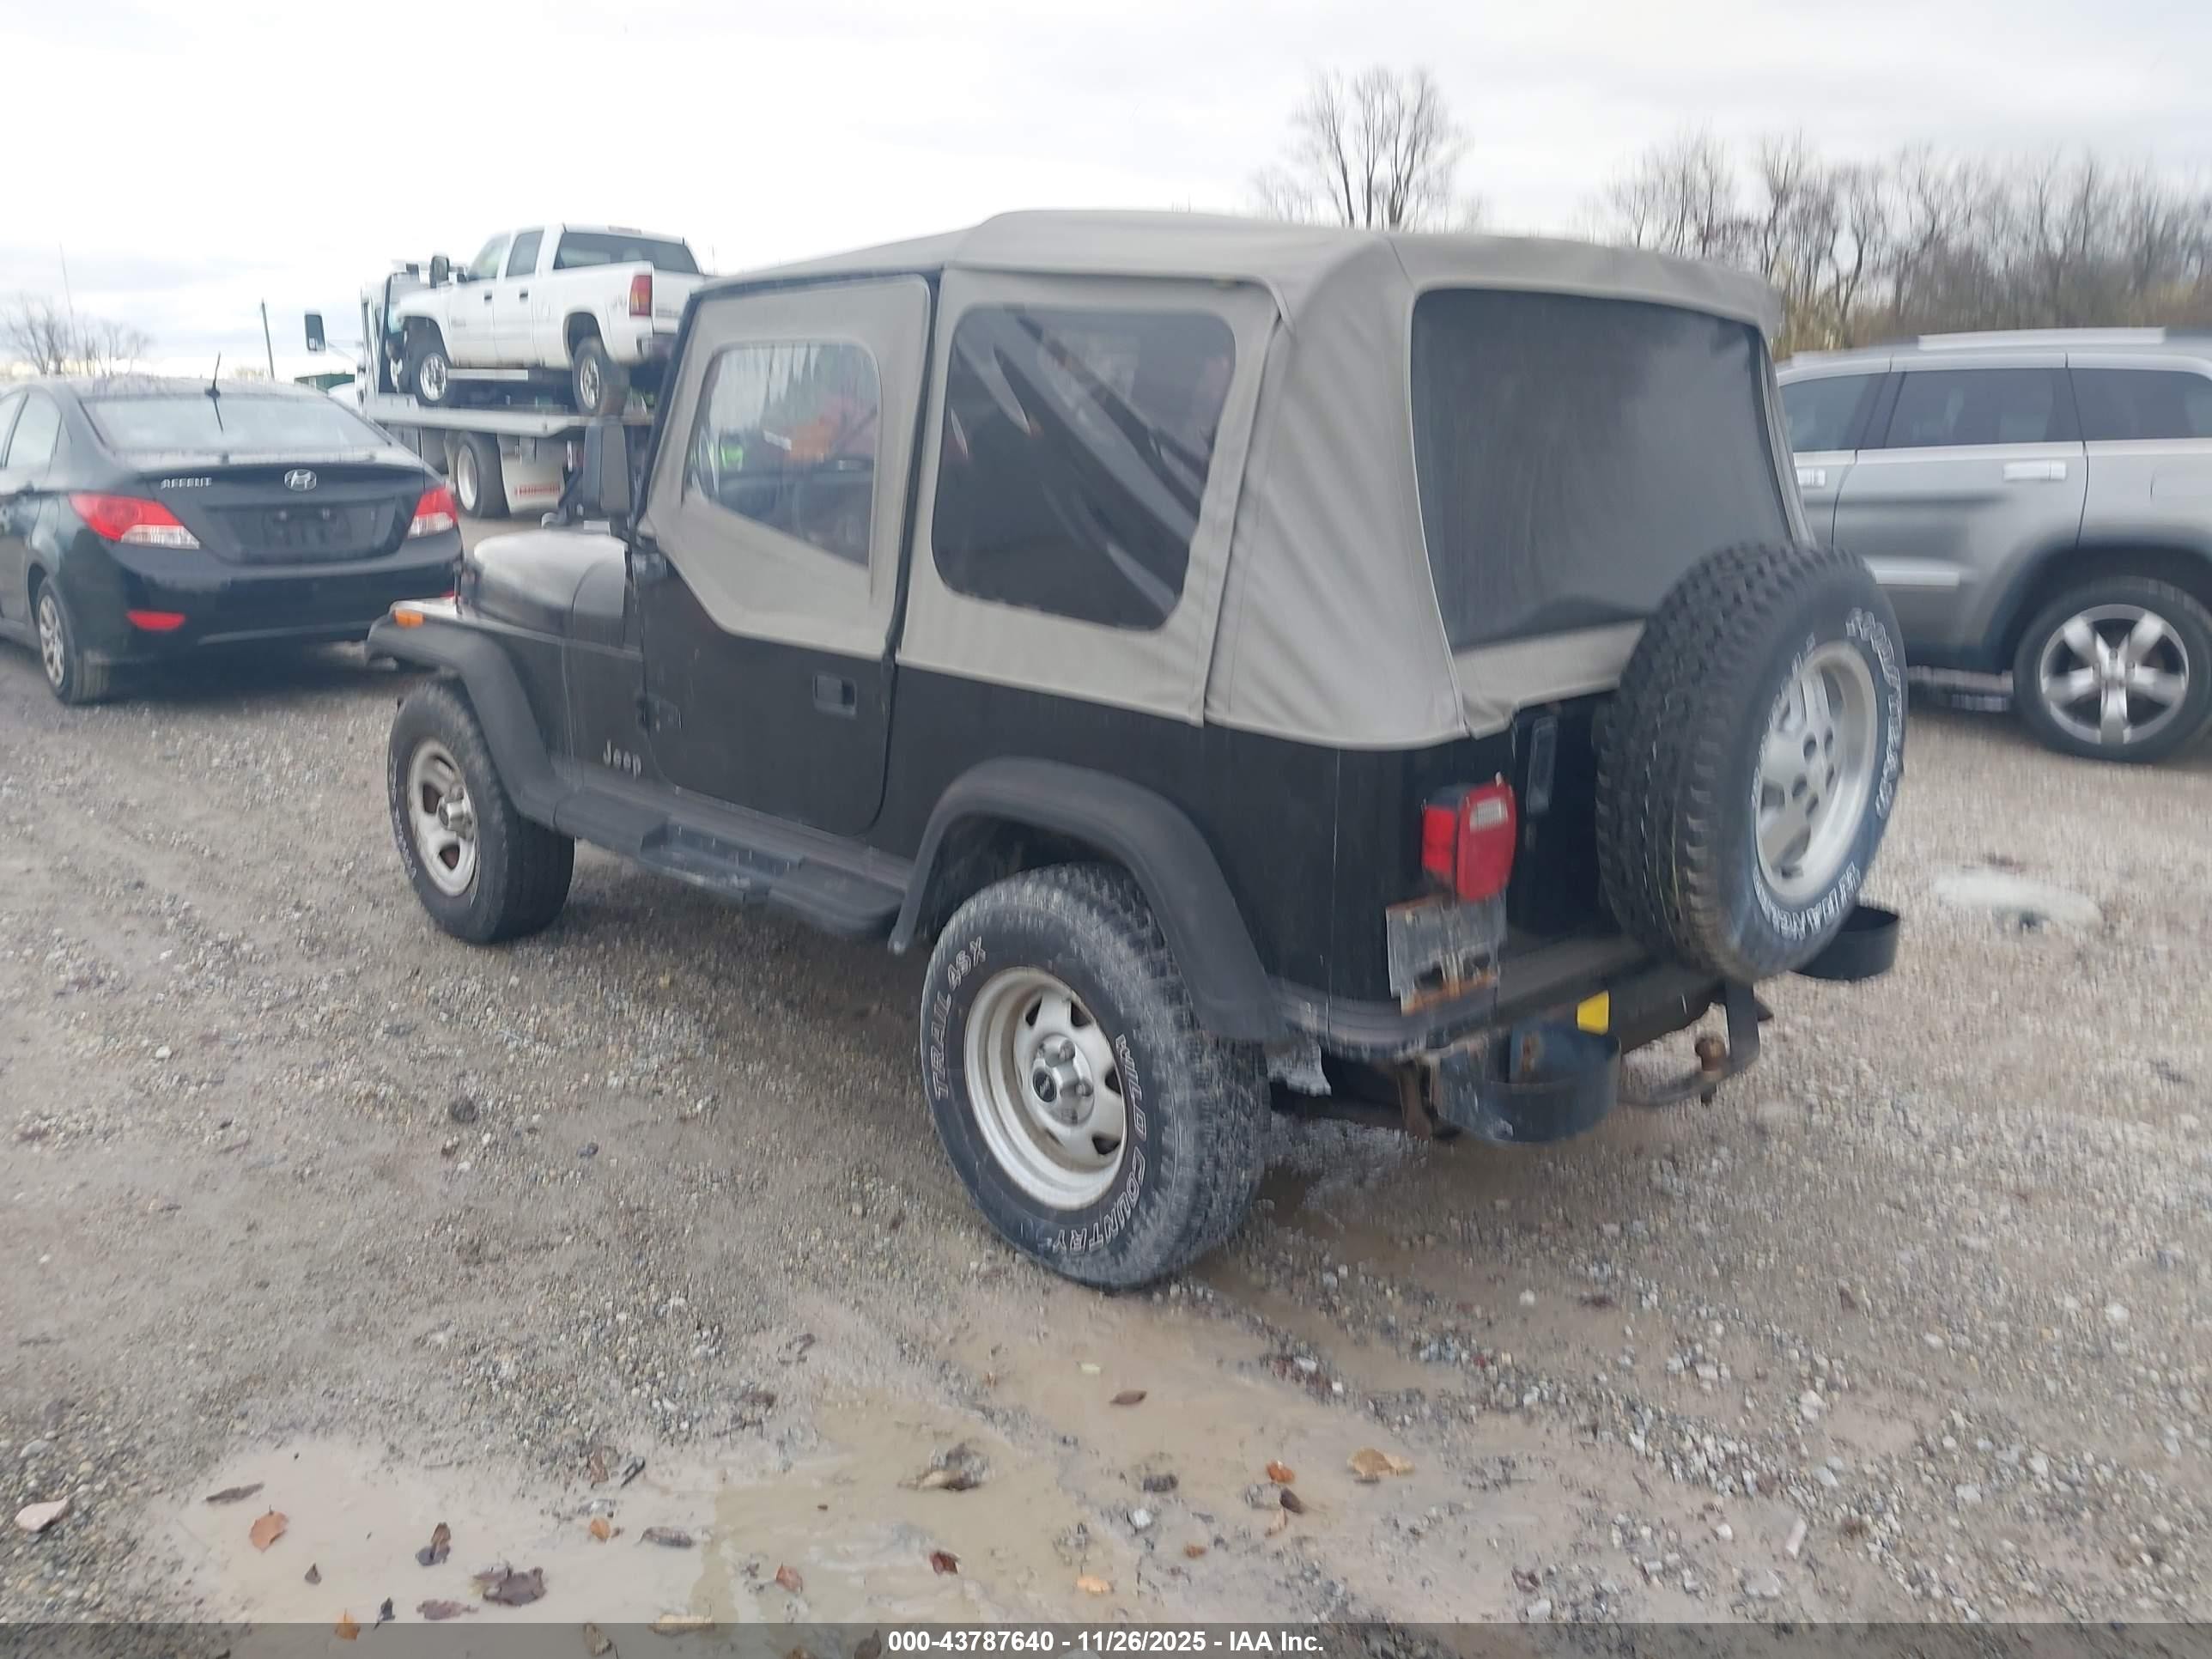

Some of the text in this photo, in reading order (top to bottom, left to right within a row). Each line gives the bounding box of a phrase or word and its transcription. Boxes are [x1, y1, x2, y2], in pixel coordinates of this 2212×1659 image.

[603, 739, 641, 779] Jeep
[930, 988, 952, 1101] TRAIL
[1053, 1033, 1147, 1255] WILD COUNTRY
